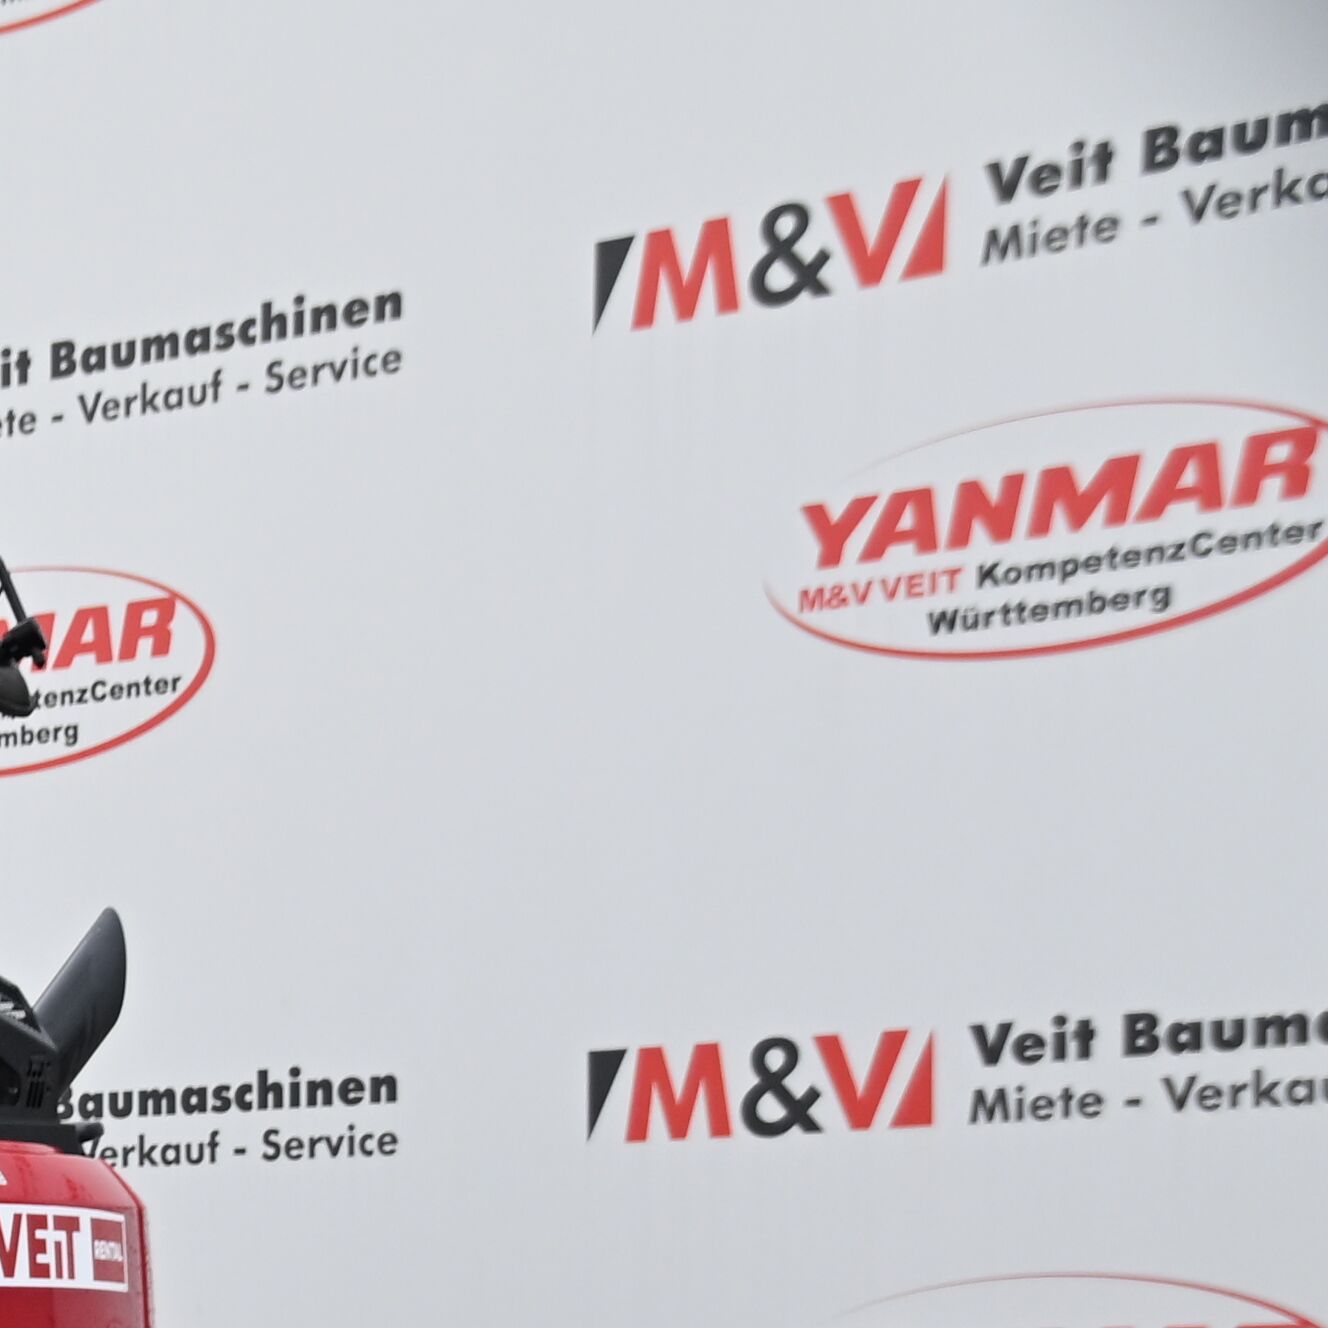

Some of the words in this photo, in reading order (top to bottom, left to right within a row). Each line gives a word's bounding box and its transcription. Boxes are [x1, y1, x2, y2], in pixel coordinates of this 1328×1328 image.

[984, 136, 1116, 205] Veit
[630, 174, 924, 332] M&V
[980, 211, 1120, 268] Miete
[50, 290, 404, 381] Baumaschinen
[77, 369, 224, 424] Verkauf
[265, 344, 403, 394] Service
[800, 426, 1318, 570] YANMAR
[798, 581, 872, 614] M&V
[882, 567, 965, 600] VEIT
[976, 518, 1324, 590] KompetenzCenter
[928, 582, 1173, 637] Württemberg
[968, 1011, 1095, 1067] Veit
[624, 1027, 909, 1144] M&V
[967, 1084, 1104, 1124] Miete
[1159, 1068, 1328, 1113] Verka
[261, 1125, 398, 1161] Service
